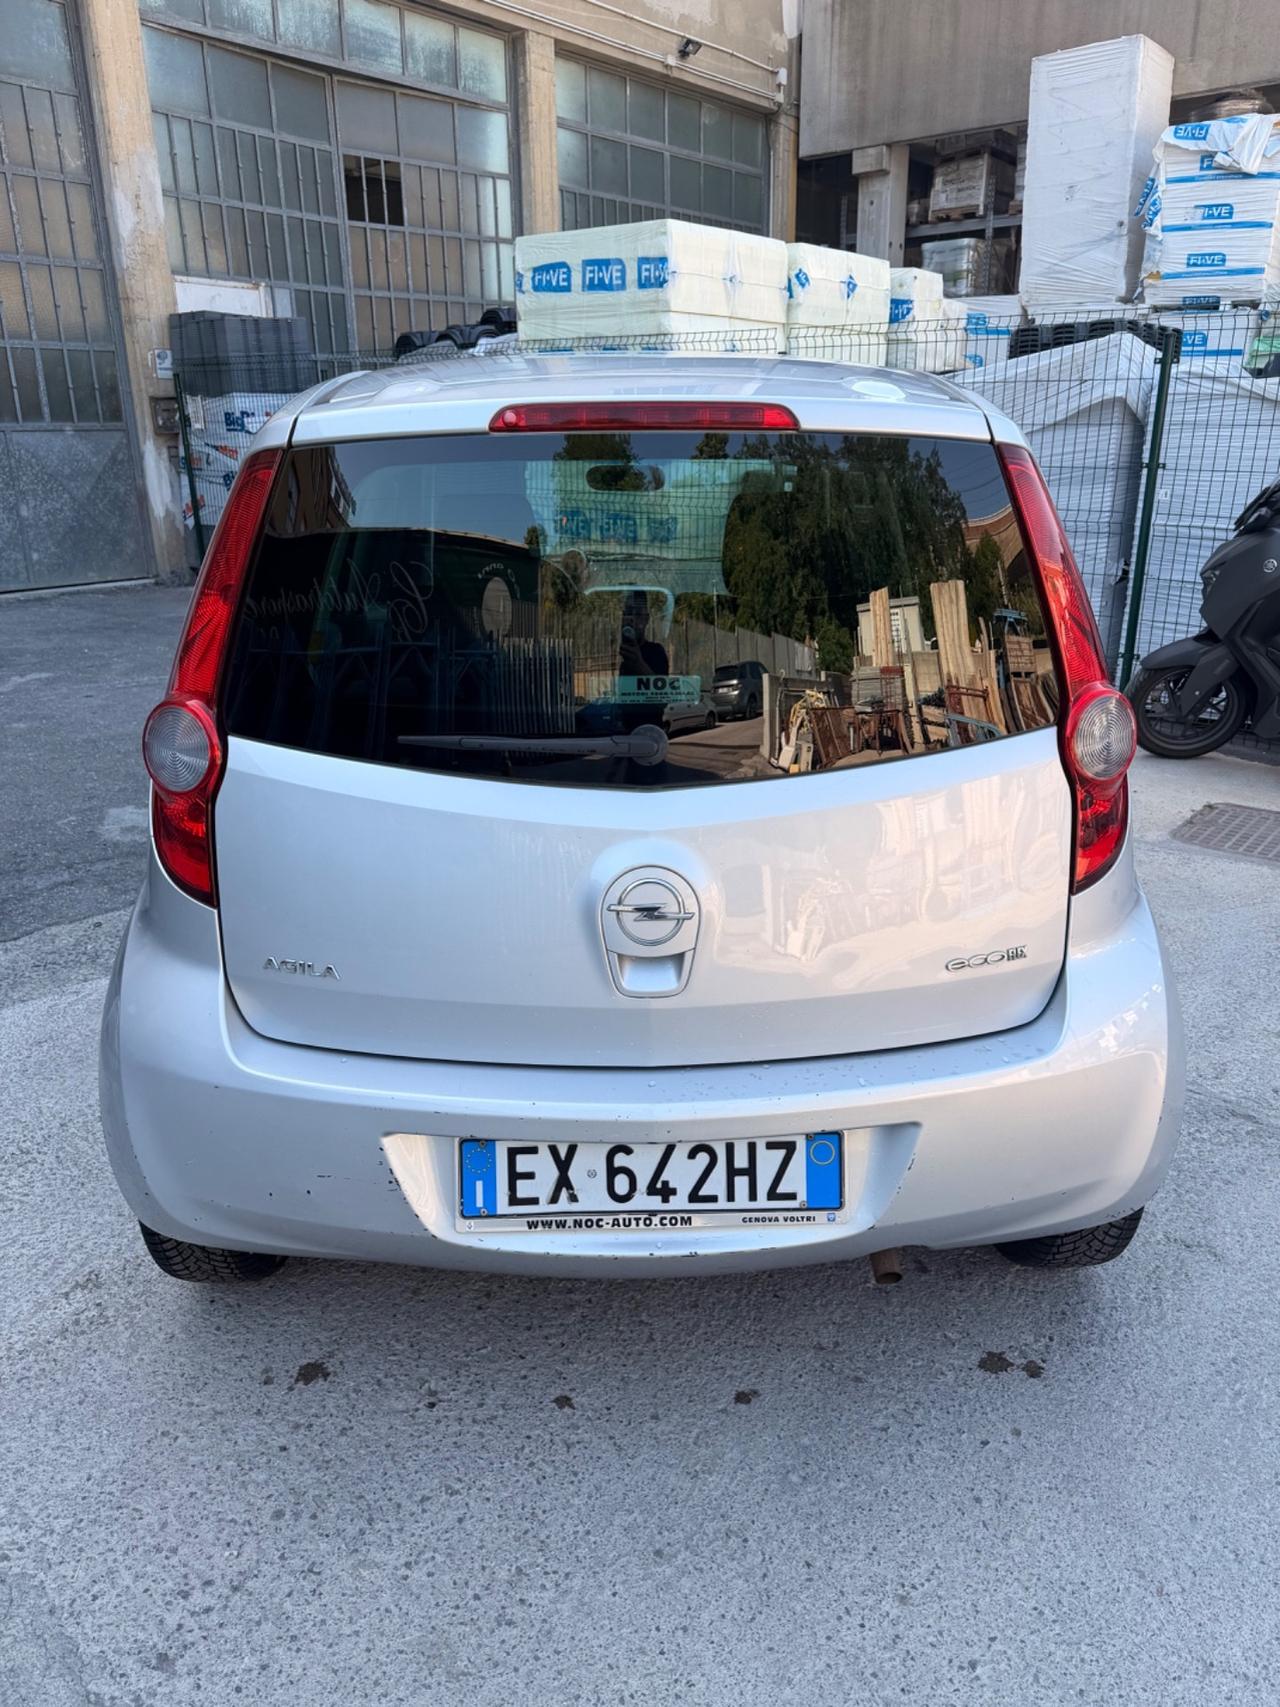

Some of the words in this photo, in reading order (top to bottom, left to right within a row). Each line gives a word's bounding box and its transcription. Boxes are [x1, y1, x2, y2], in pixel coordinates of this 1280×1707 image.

[263, 956, 342, 981] AGILA
[507, 1143, 579, 1207] EX
[605, 1140, 798, 1204] 642HZ
[526, 1214, 693, 1230] WWW.NOC-AUTO.COM
[741, 1215, 780, 1224] GENOVA
[782, 1215, 817, 1223] VOLTRI
